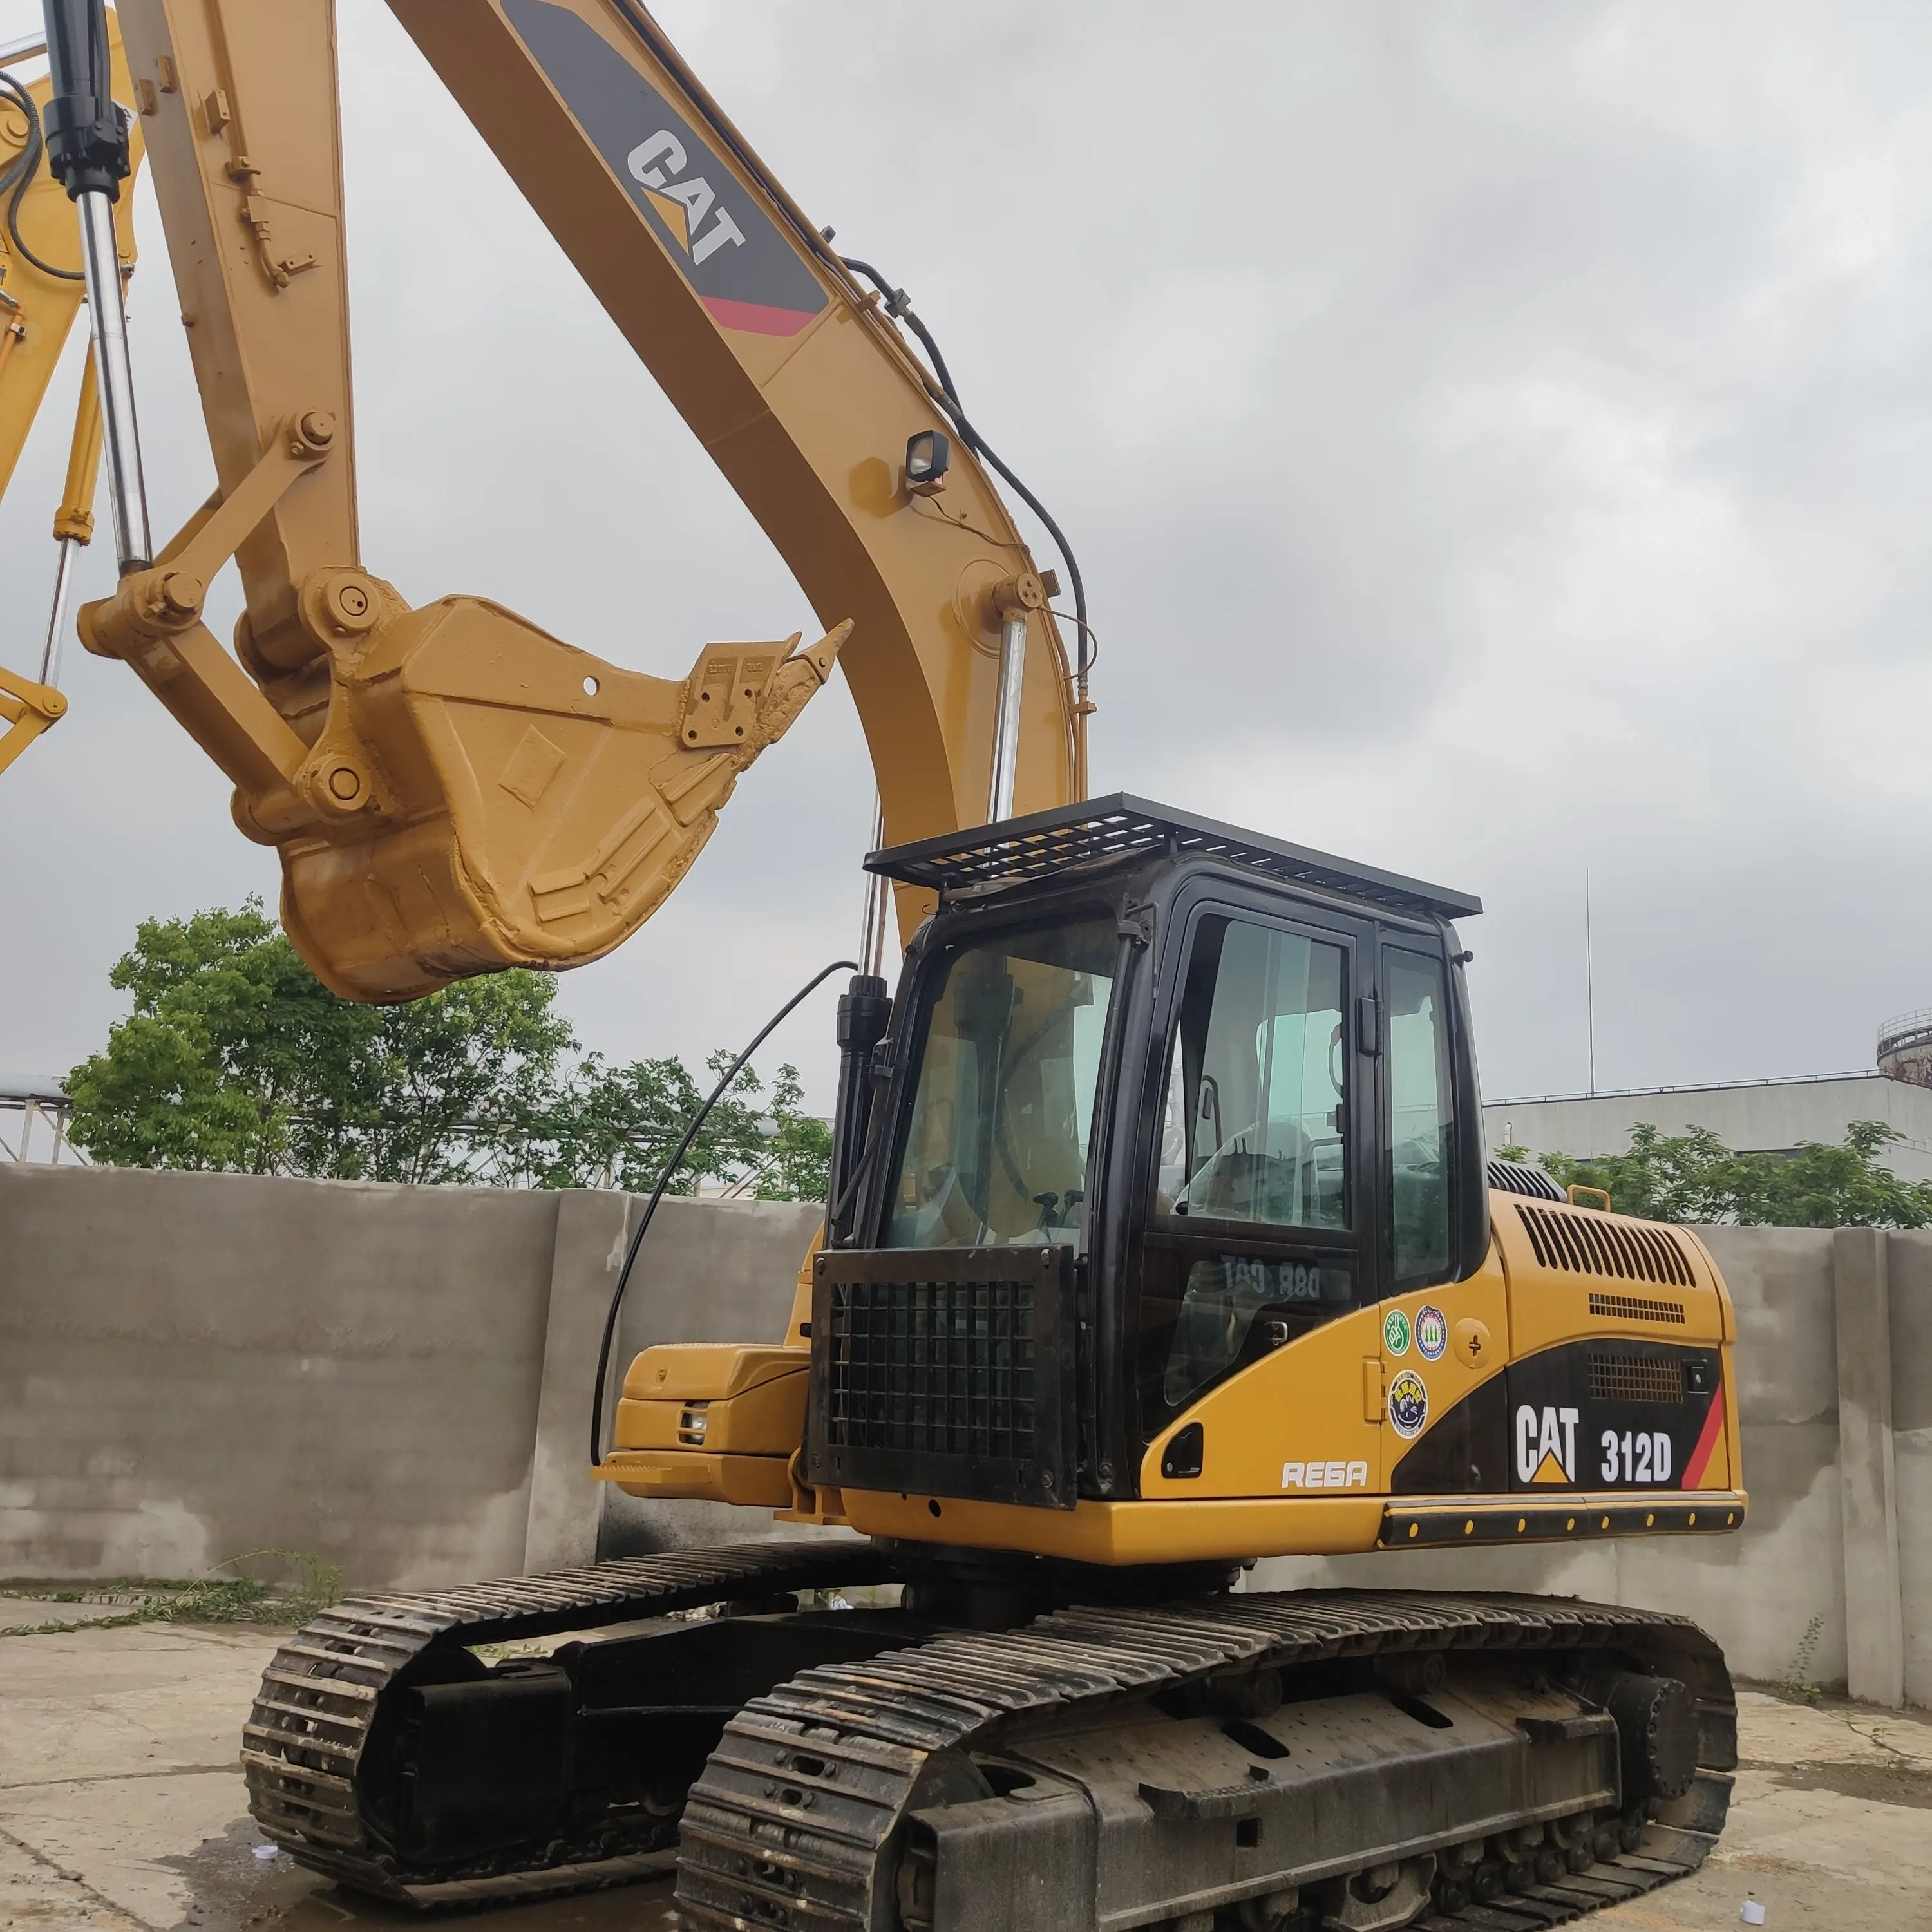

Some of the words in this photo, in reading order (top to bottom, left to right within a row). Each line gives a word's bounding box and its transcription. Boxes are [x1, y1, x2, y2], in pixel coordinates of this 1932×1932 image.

[627, 129, 746, 265] CAT
[1282, 1461, 1367, 1488] REGA
[1516, 1405, 1579, 1483] CAT
[1601, 1430, 1671, 1482] 312D
